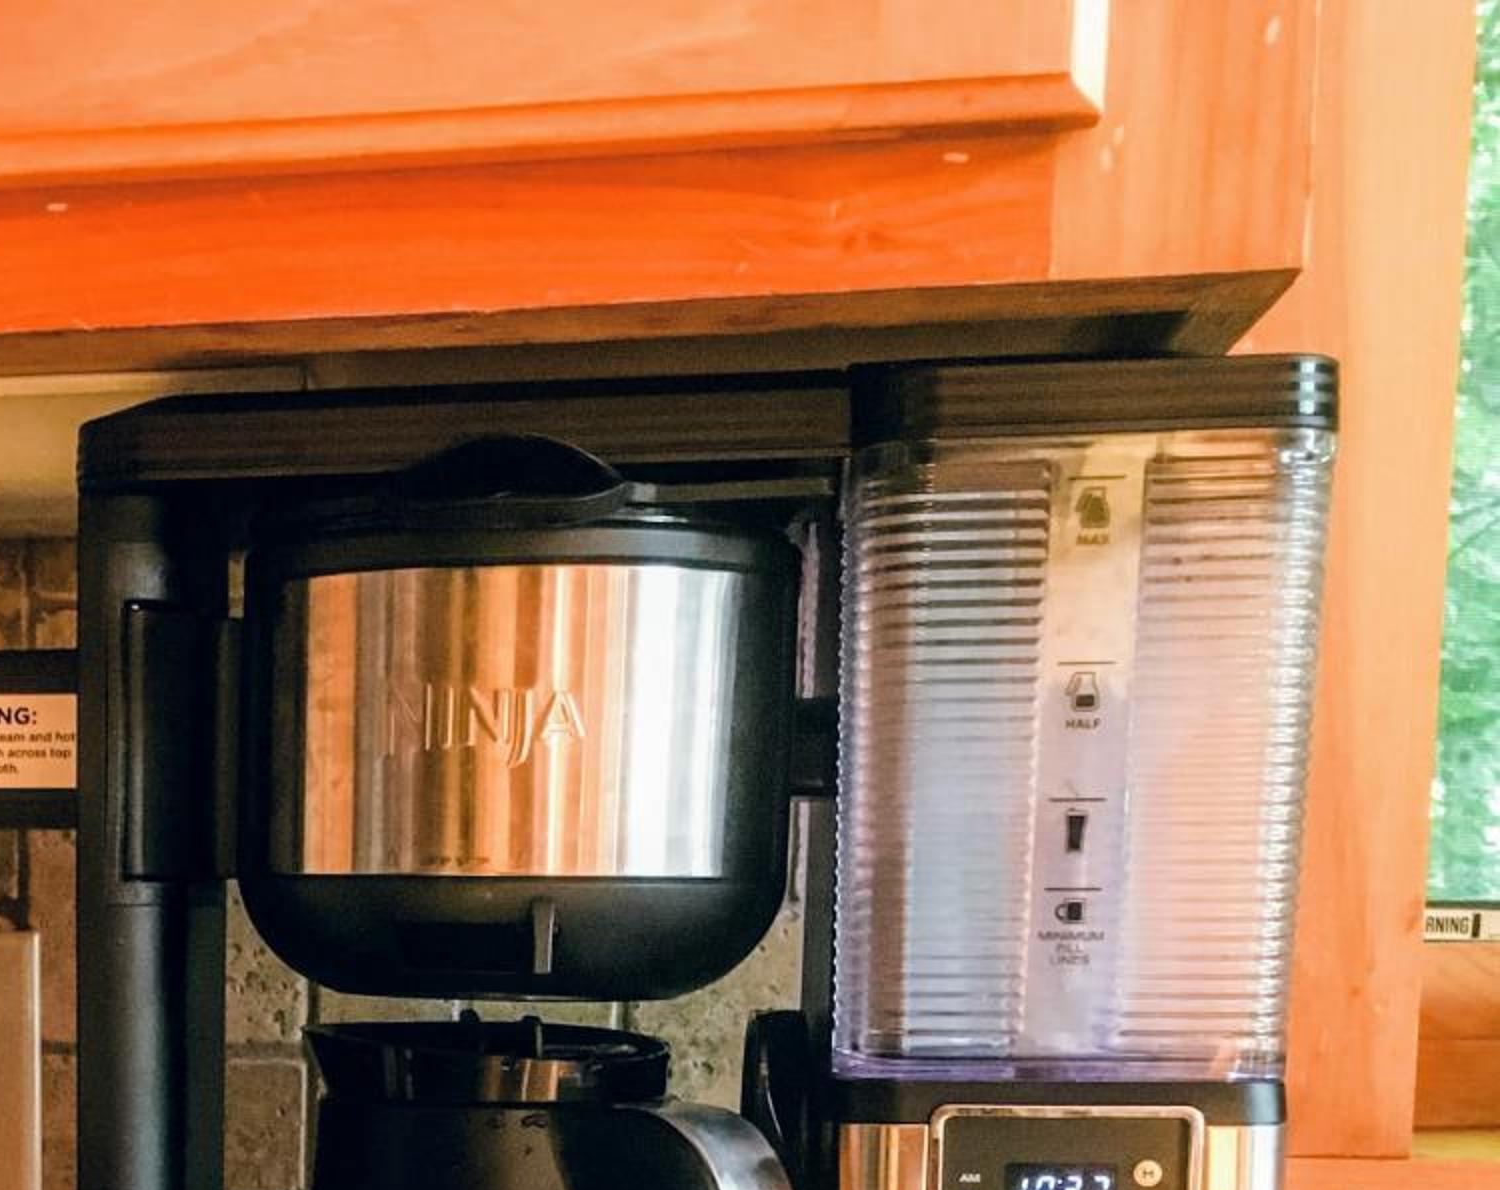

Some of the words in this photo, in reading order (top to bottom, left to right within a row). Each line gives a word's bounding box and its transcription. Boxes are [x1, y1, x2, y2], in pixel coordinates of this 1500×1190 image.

[388, 682, 586, 769] NINJA
[1065, 719, 1101, 730] HALF
[29, 732, 50, 743] and
[7, 749, 46, 759] across
[50, 748, 71, 761] top
[959, 1173, 981, 1183] AM
